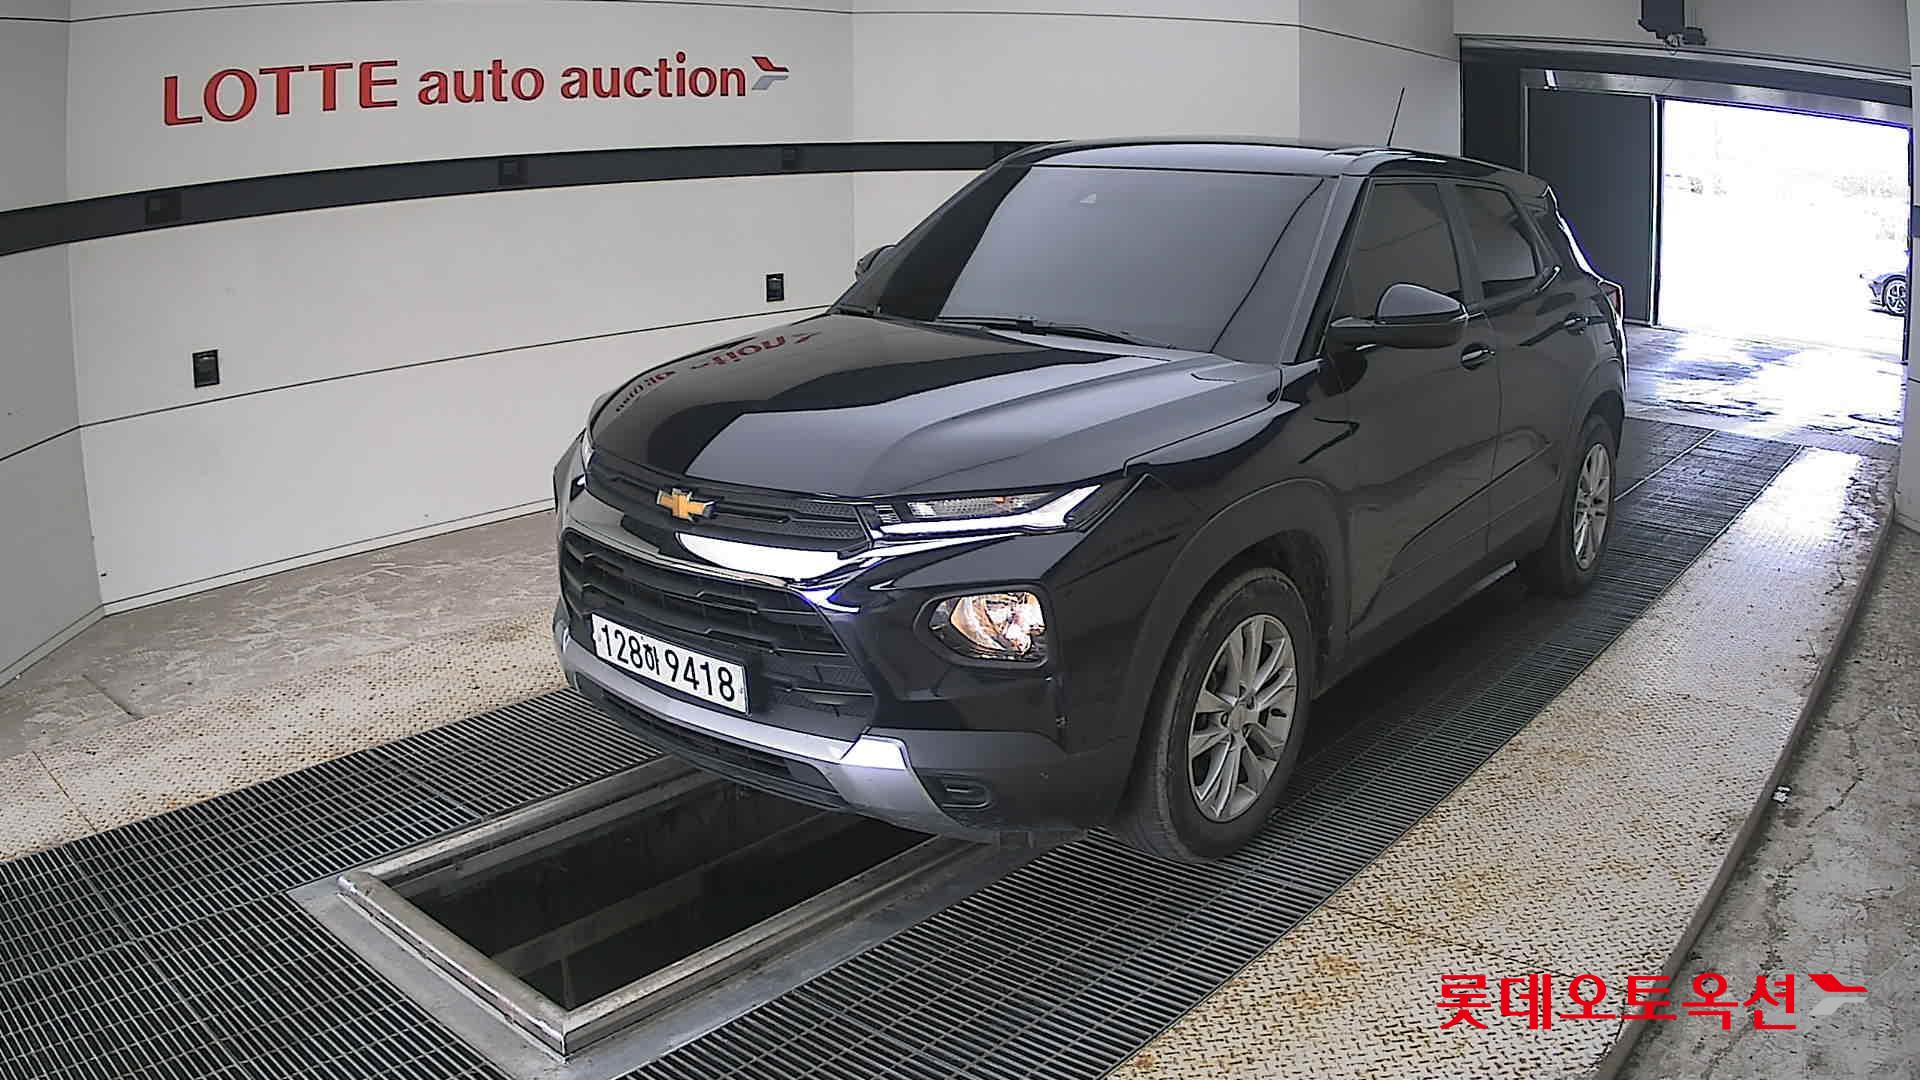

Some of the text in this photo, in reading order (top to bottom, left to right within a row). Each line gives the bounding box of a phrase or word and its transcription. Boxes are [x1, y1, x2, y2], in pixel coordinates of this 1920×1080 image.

[163, 51, 748, 126] LOTTE auto auction
[664, 649, 736, 702] 9418
